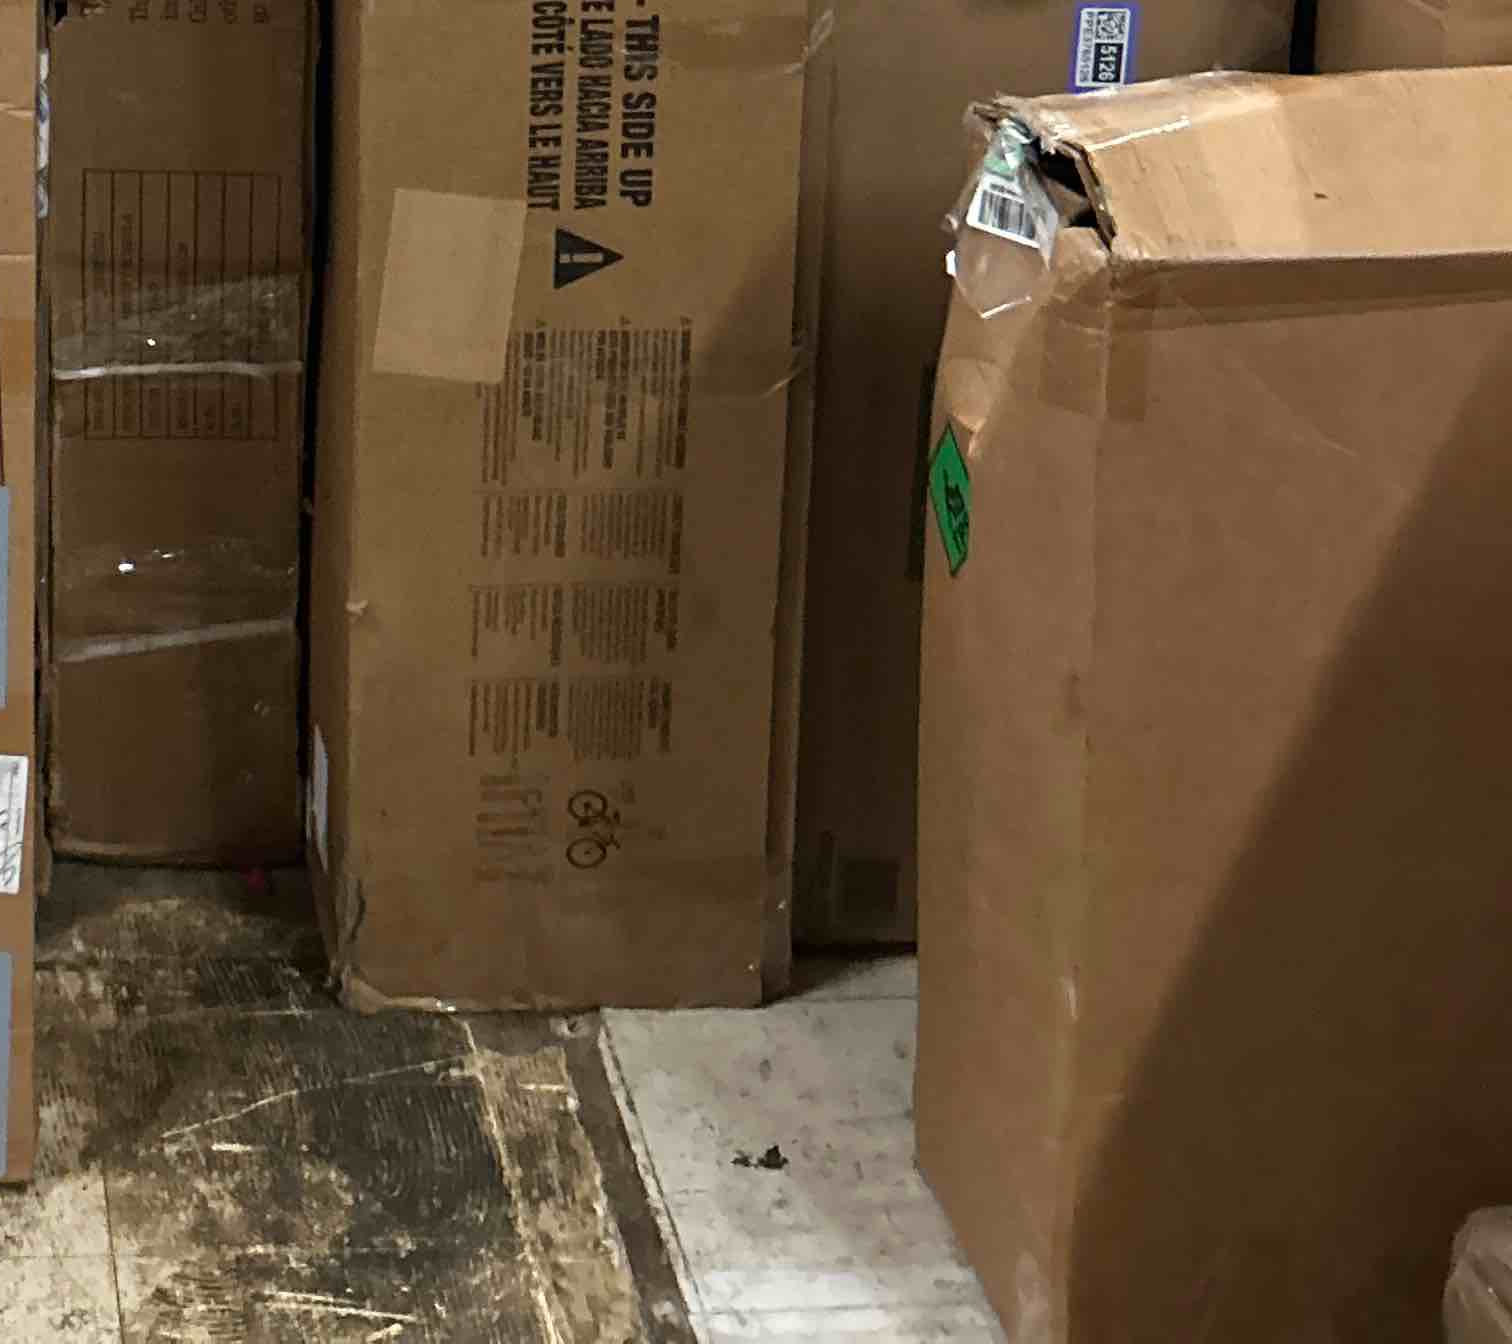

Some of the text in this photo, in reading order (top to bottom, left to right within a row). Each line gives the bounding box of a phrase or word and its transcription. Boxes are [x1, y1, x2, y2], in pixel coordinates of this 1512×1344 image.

[579, 18, 615, 68] LADO
[624, 15, 661, 81] THIS
[1099, 44, 1117, 82] 5126
[529, 62, 566, 116] VERS
[576, 75, 613, 132] HACIA
[528, 123, 563, 151] LE
[621, 92, 657, 160] SIDE
[527, 157, 560, 211] HAUT
[574, 137, 609, 210] ARRIBA
[619, 168, 654, 208] UP
